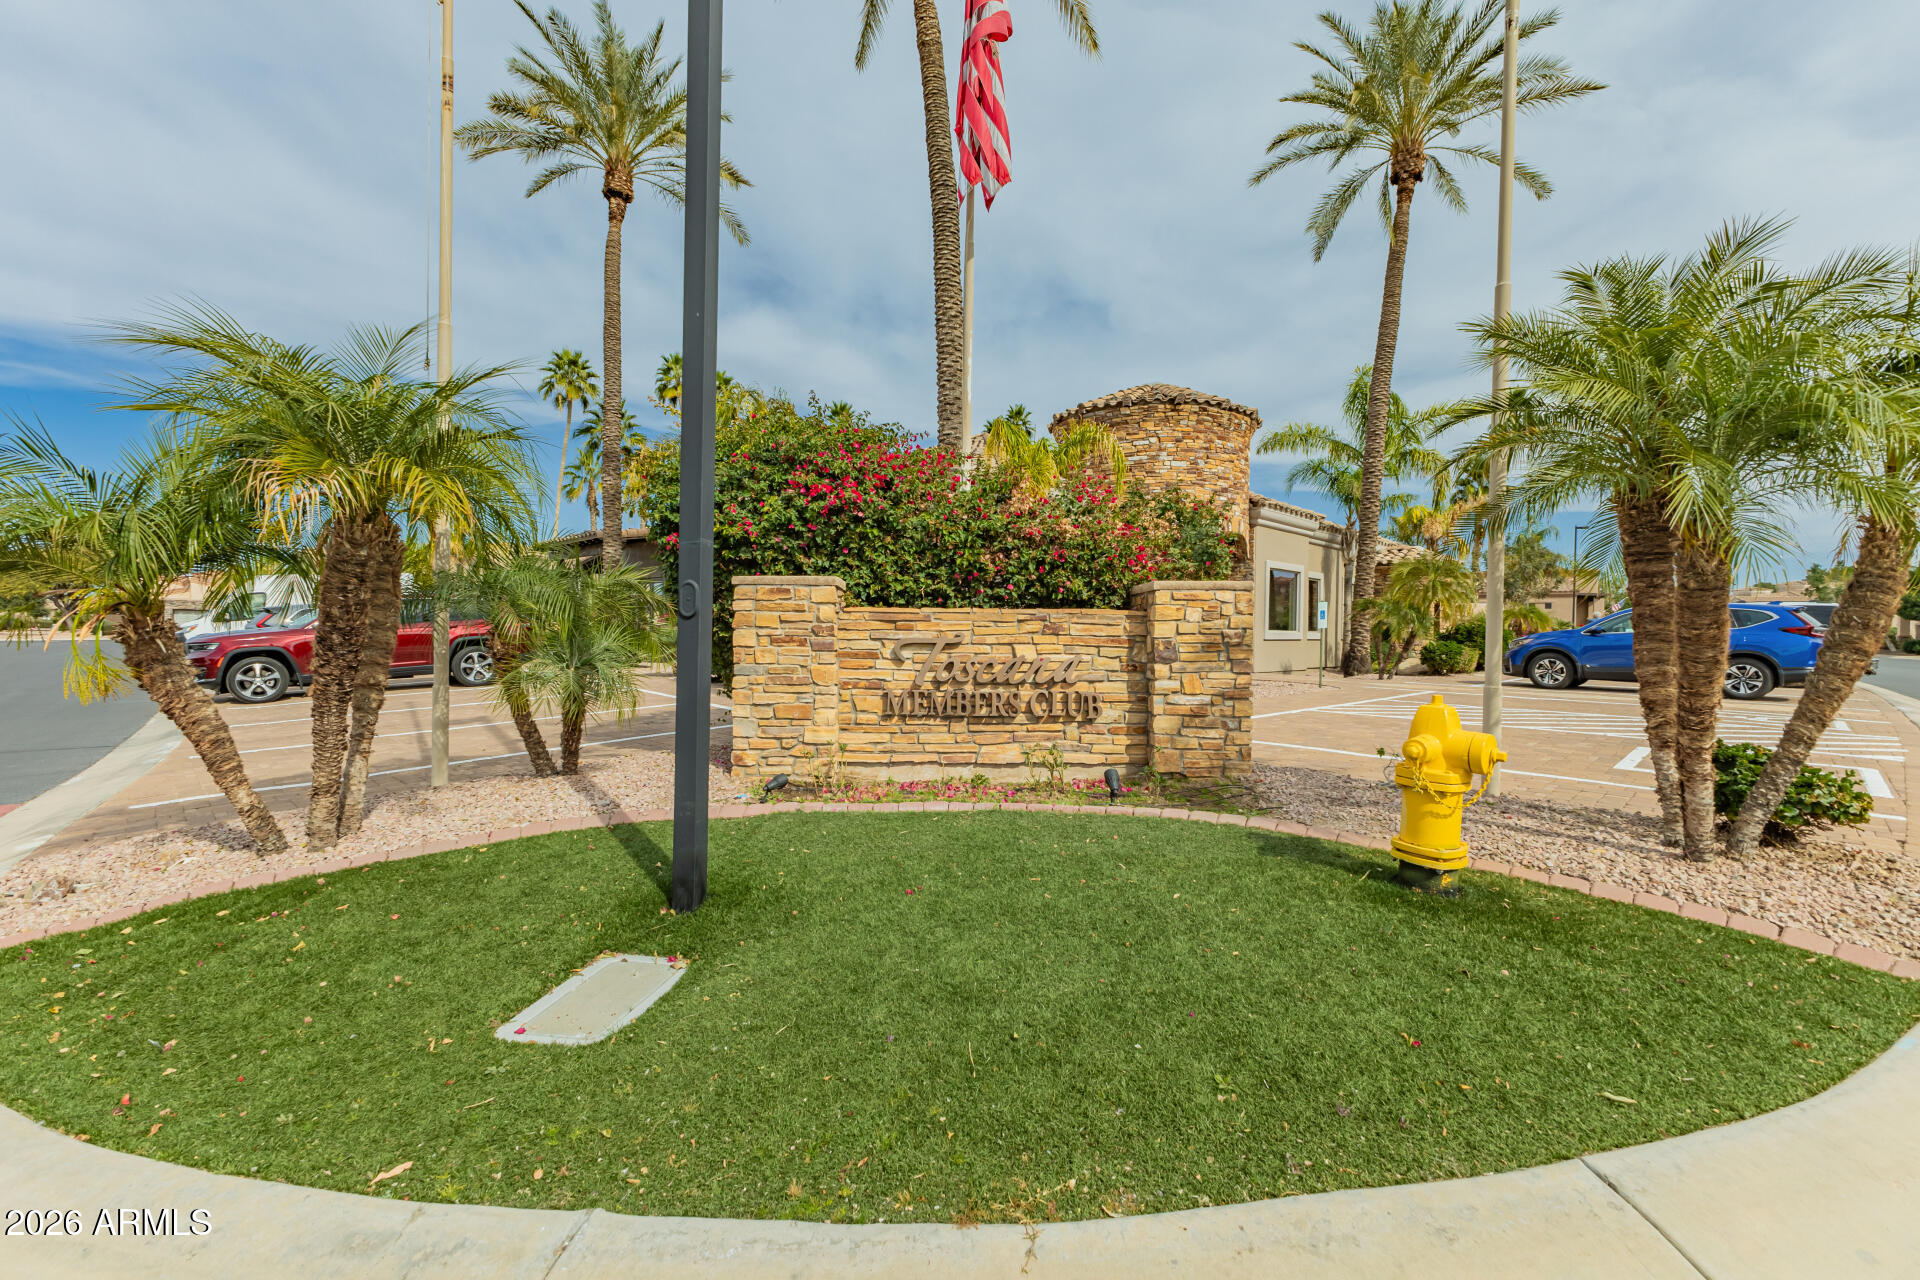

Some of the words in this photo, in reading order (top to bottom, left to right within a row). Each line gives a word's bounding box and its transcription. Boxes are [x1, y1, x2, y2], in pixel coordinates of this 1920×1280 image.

[892, 632, 1107, 686] Toscana
[885, 689, 1022, 717] MEMBERS
[1030, 689, 1103, 719] CLUB
